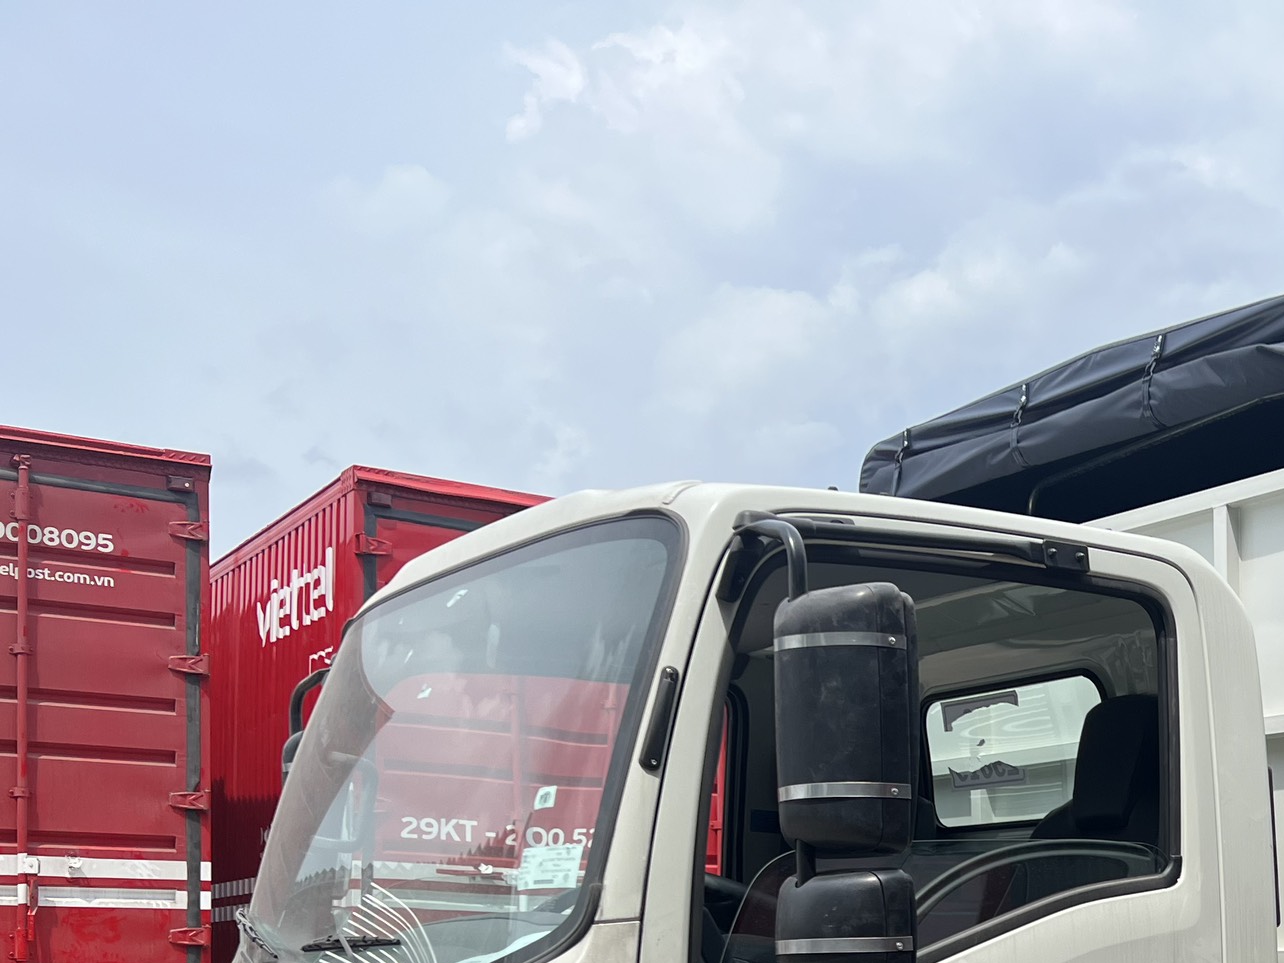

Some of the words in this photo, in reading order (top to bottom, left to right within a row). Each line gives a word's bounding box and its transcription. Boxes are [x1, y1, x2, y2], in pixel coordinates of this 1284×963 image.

[0, 522, 115, 553] 008095
[256, 546, 334, 647] viettel
[400, 816, 478, 842] 29KT
